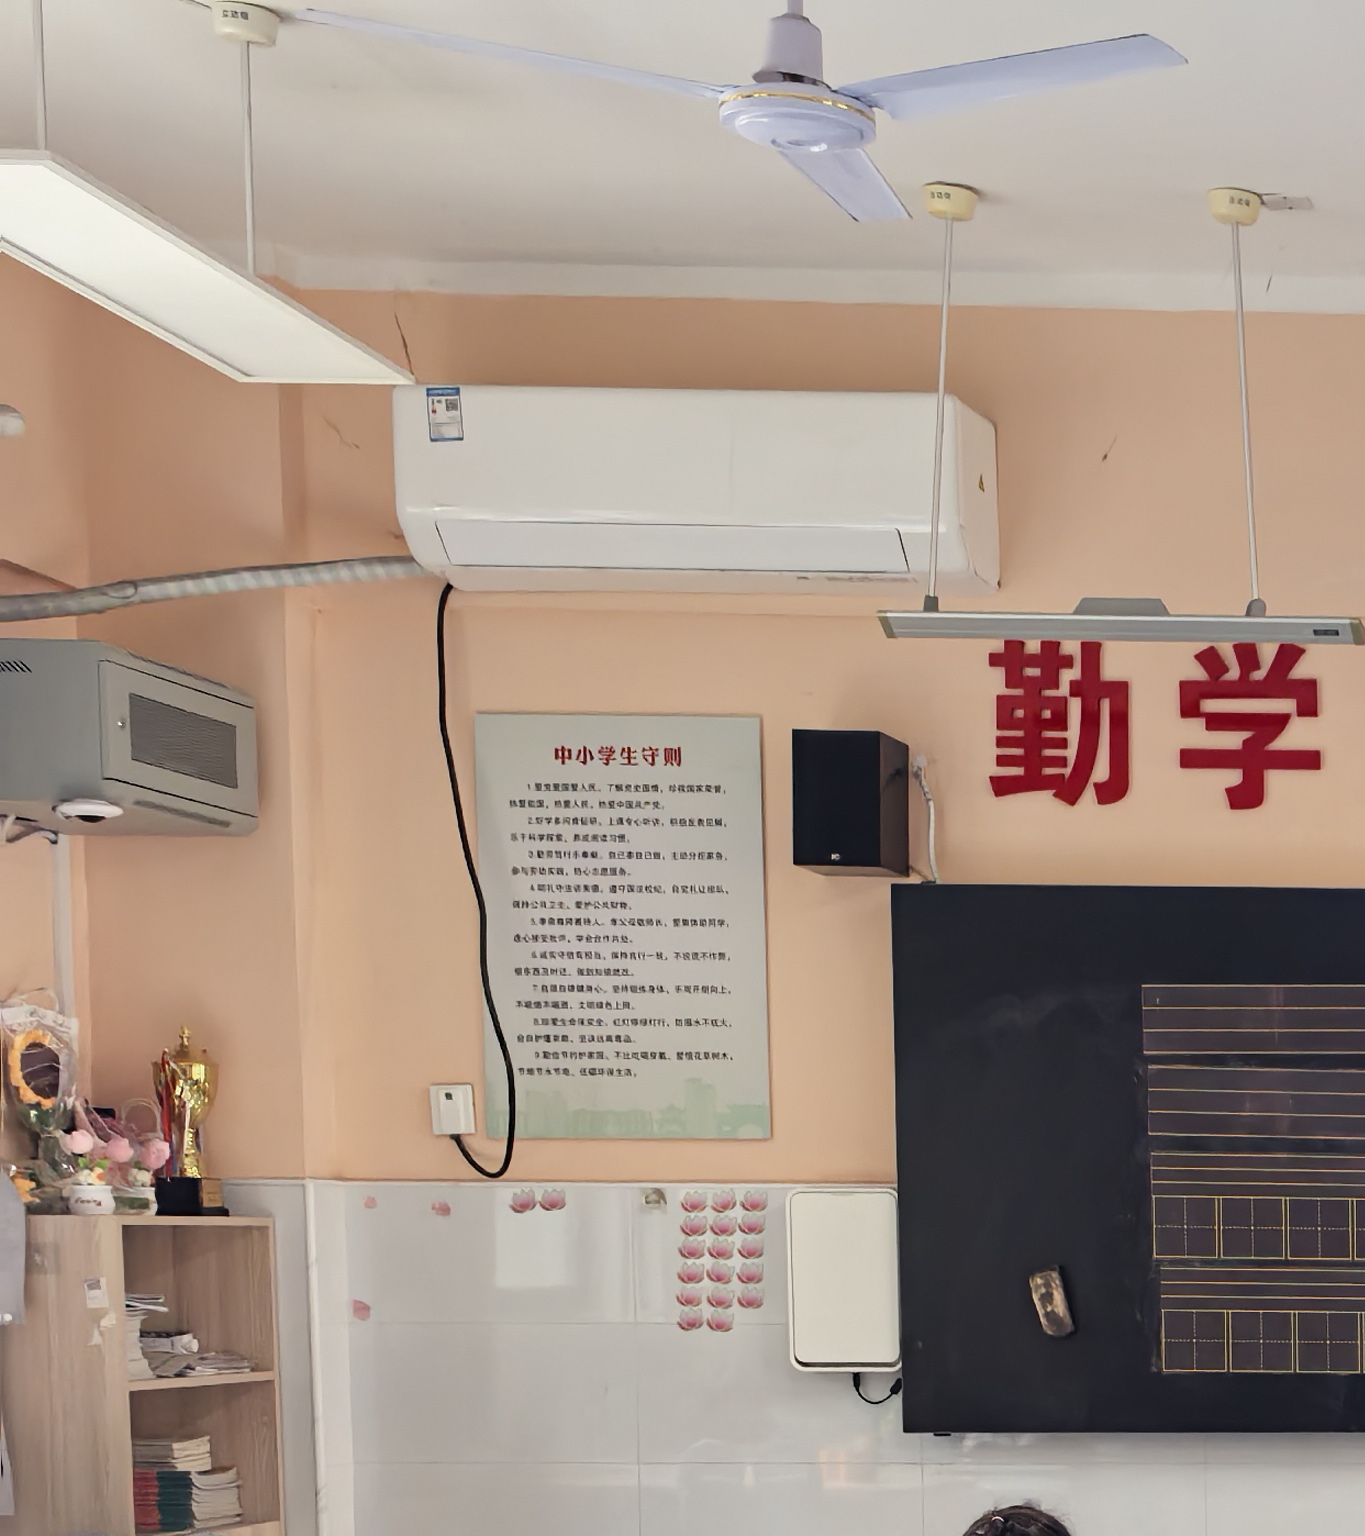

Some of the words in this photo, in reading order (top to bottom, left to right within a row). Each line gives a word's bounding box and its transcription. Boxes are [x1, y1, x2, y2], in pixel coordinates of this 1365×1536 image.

[554, 745, 683, 767] 中小学生守则
